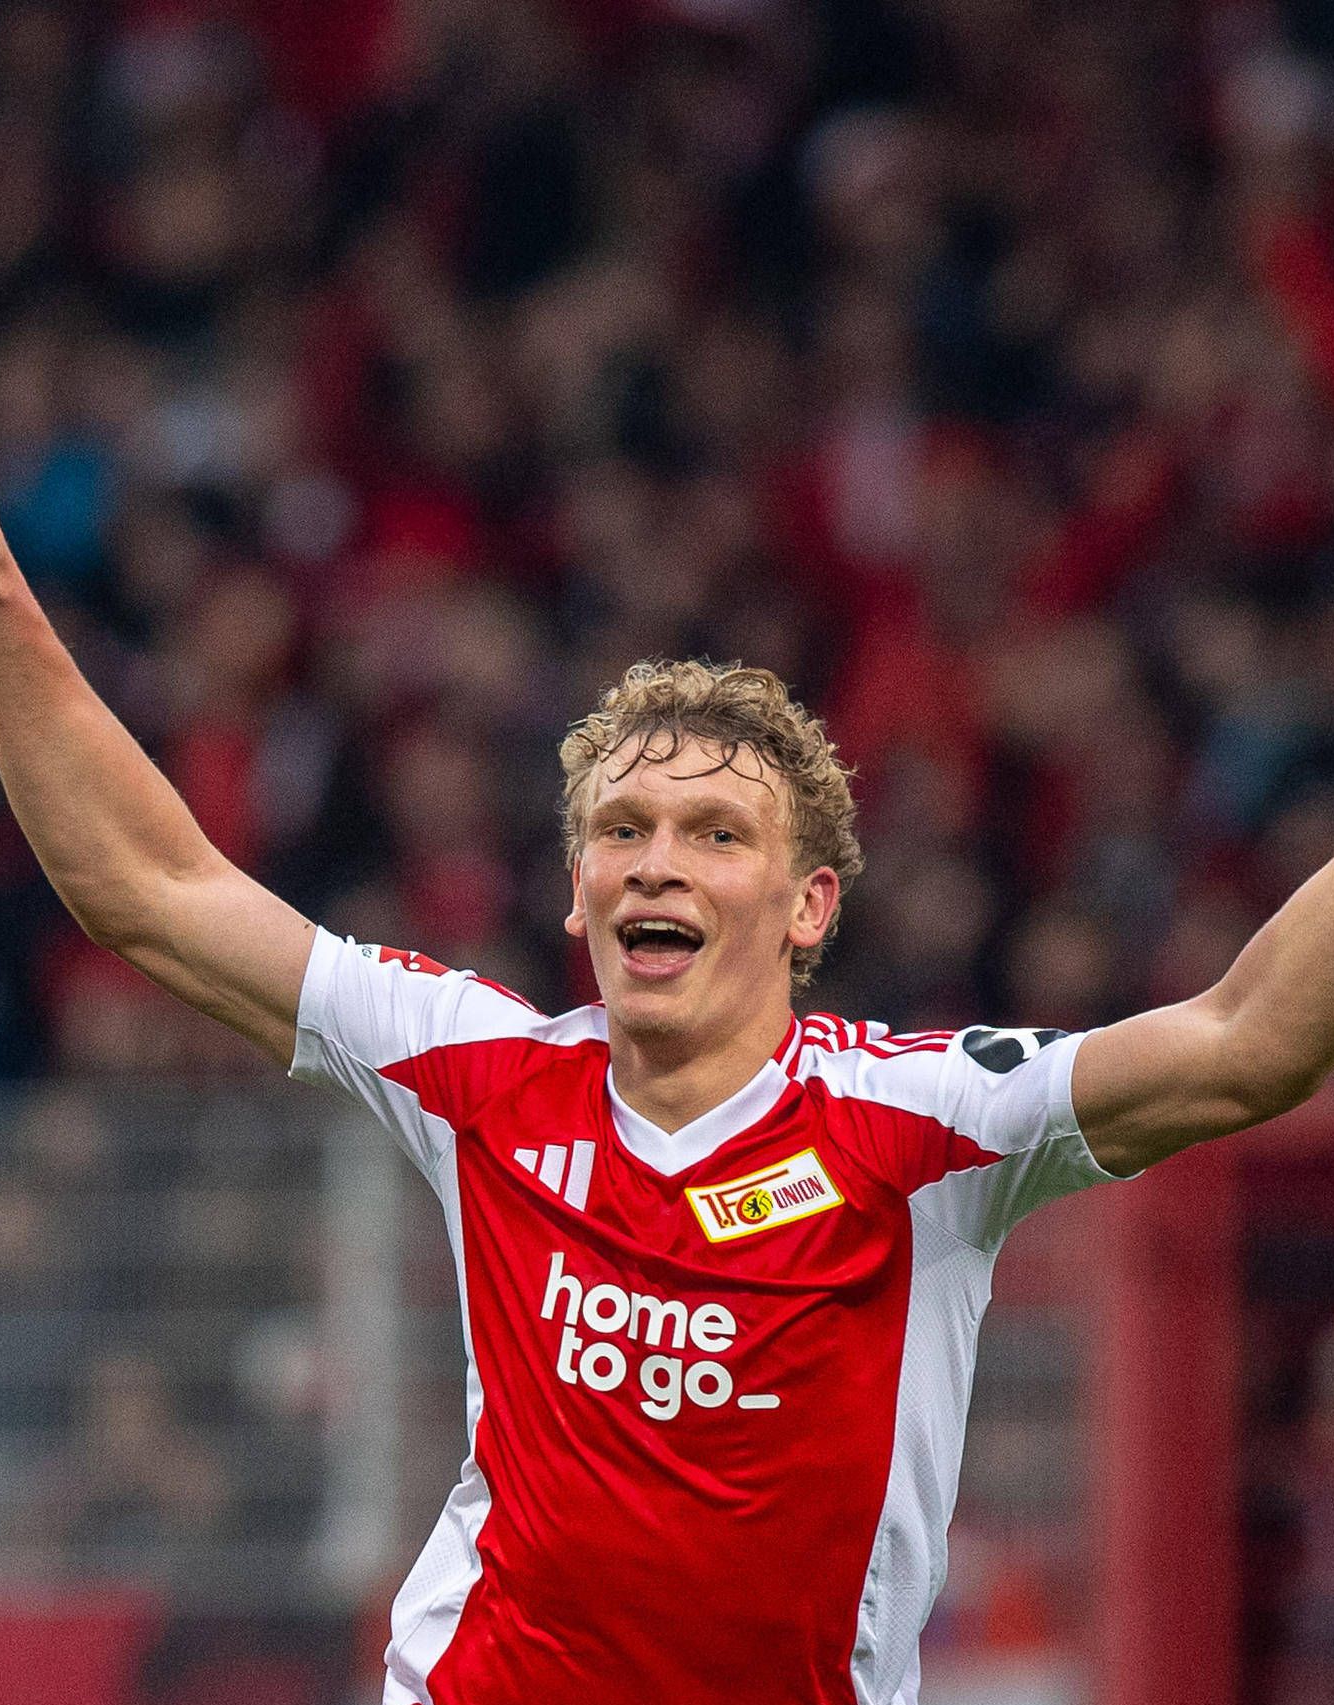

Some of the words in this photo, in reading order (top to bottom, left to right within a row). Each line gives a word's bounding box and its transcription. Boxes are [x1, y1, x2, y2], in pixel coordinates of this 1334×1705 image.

[771, 1174, 826, 1210] UNION
[540, 1251, 737, 1353] home
[556, 1325, 627, 1392] to
